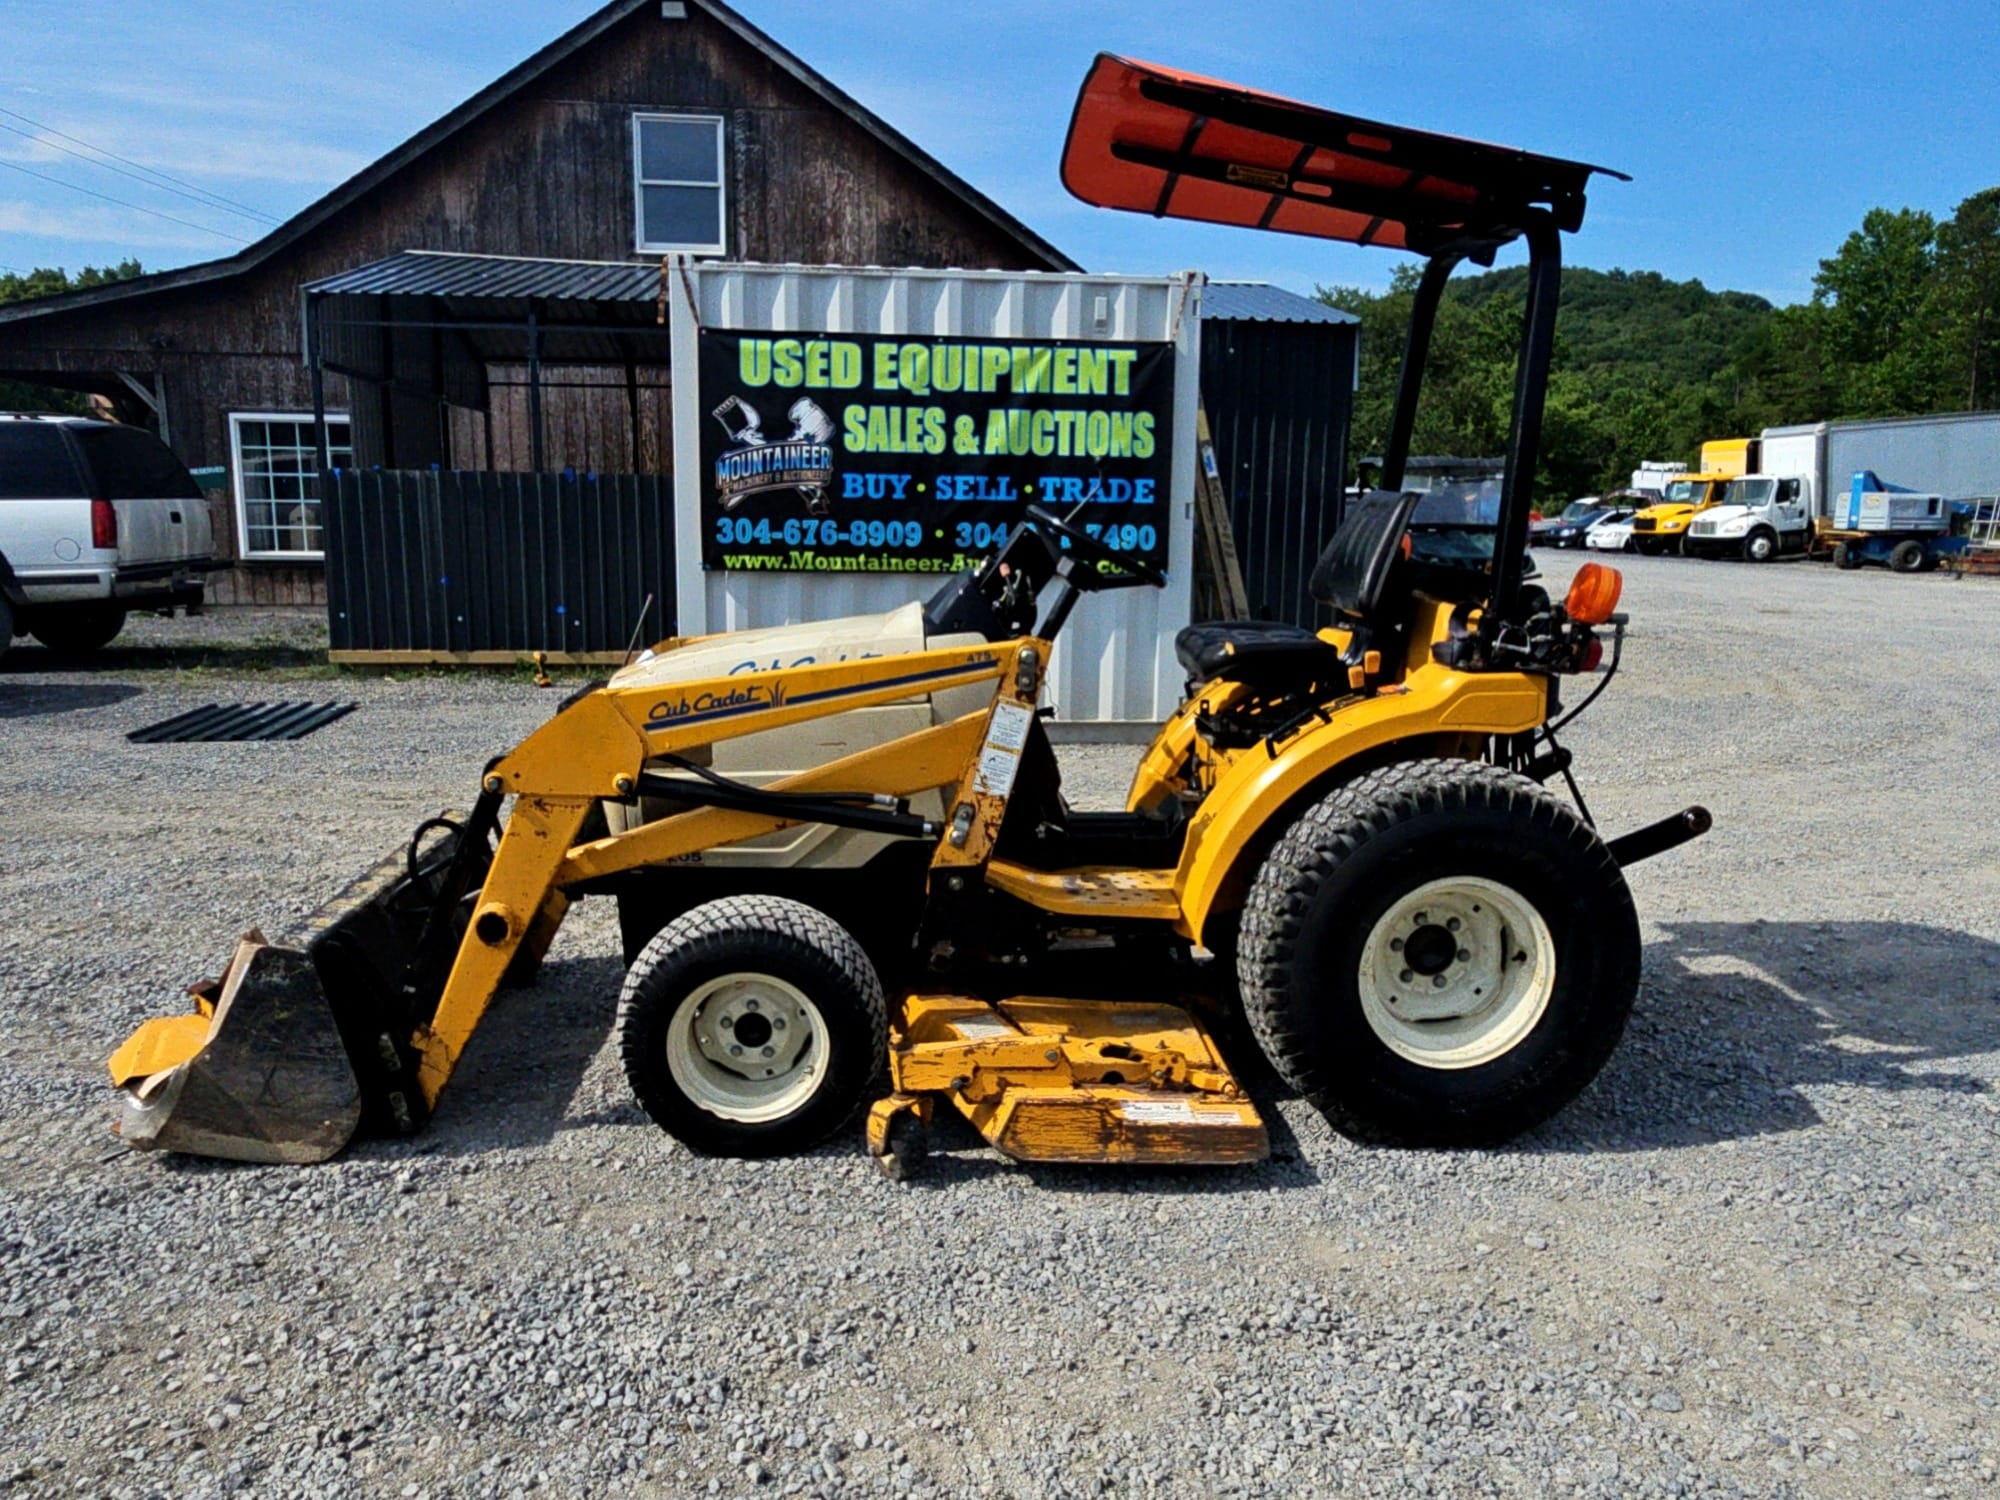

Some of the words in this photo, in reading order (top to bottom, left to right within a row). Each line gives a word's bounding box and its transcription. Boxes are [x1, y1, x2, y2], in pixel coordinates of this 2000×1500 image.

[739, 338, 862, 389] USED
[874, 341, 1137, 395] EQUIPMENT
[843, 405, 946, 454] SALES
[953, 415, 979, 455] &
[984, 409, 1155, 458] AUCTIONS
[718, 445, 831, 486] MOUNTAINEER
[842, 473, 911, 500] BUY
[936, 475, 1017, 501] SELL
[1039, 477, 1155, 503] TRADE
[716, 517, 922, 547] 304-676-8909
[649, 698, 691, 720] Cub
[693, 685, 763, 711] Cadet
